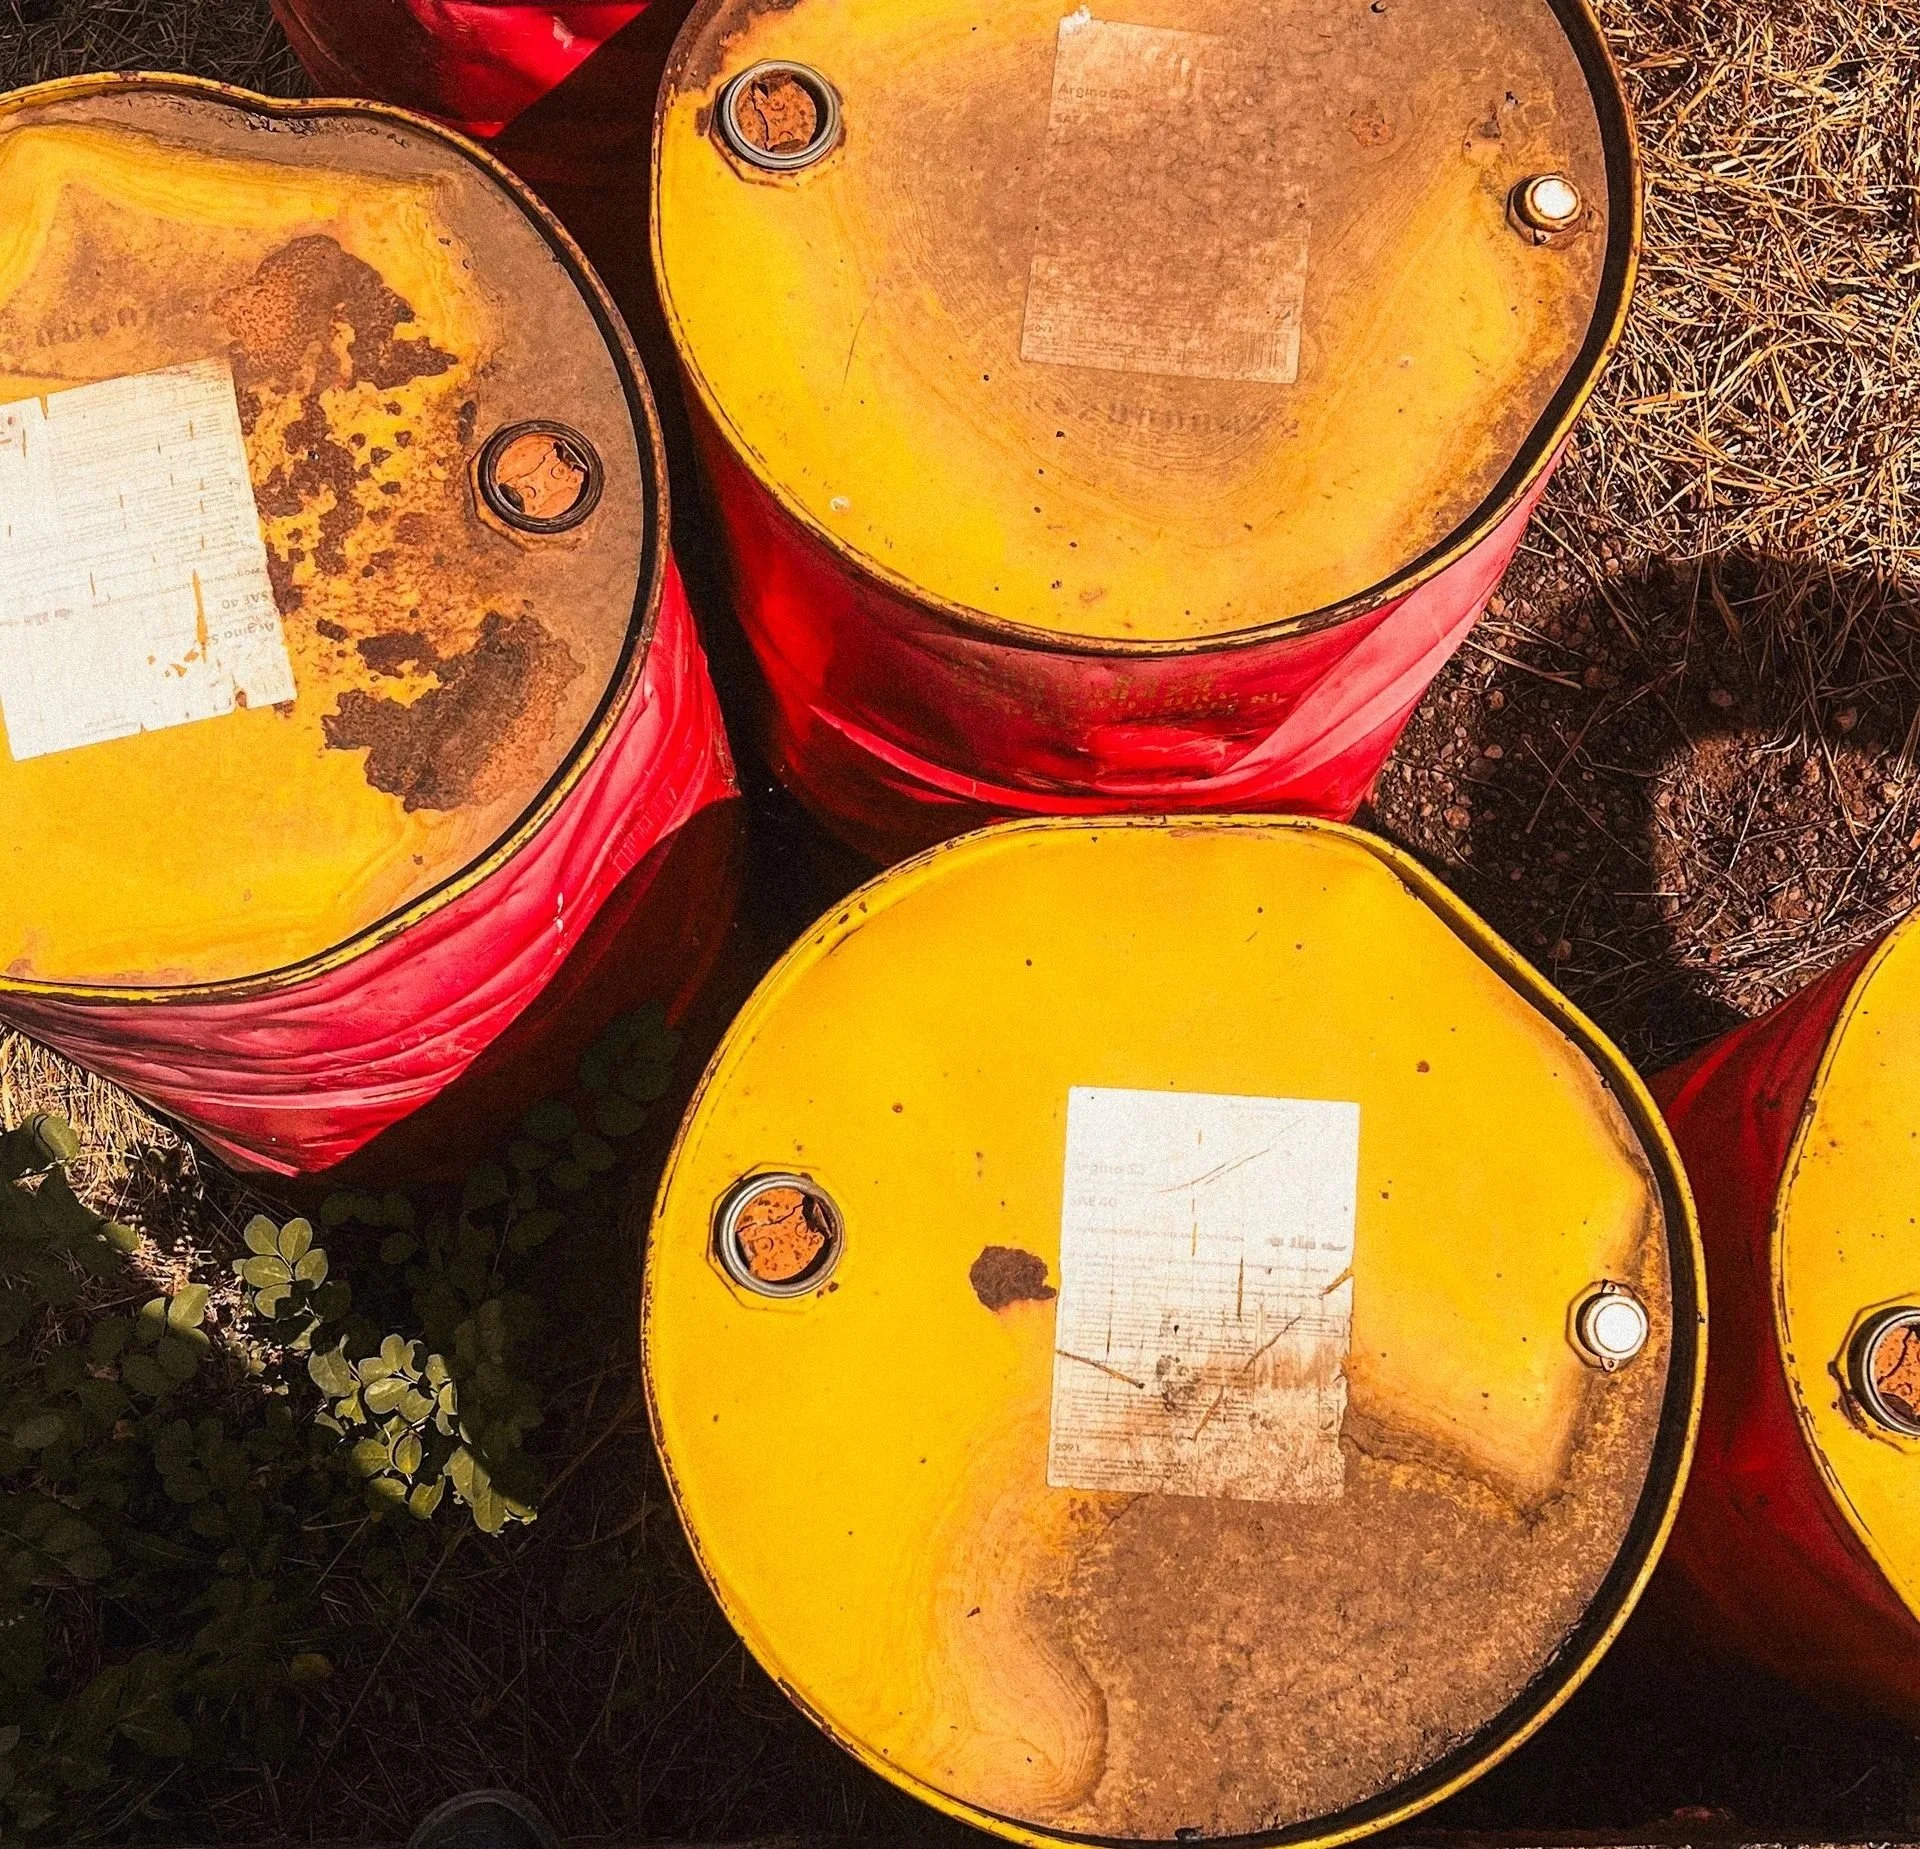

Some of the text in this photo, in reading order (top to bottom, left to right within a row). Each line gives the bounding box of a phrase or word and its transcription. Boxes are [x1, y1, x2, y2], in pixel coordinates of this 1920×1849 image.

[1057, 82, 1107, 99] Argina
[221, 590, 269, 610] SAE 40
